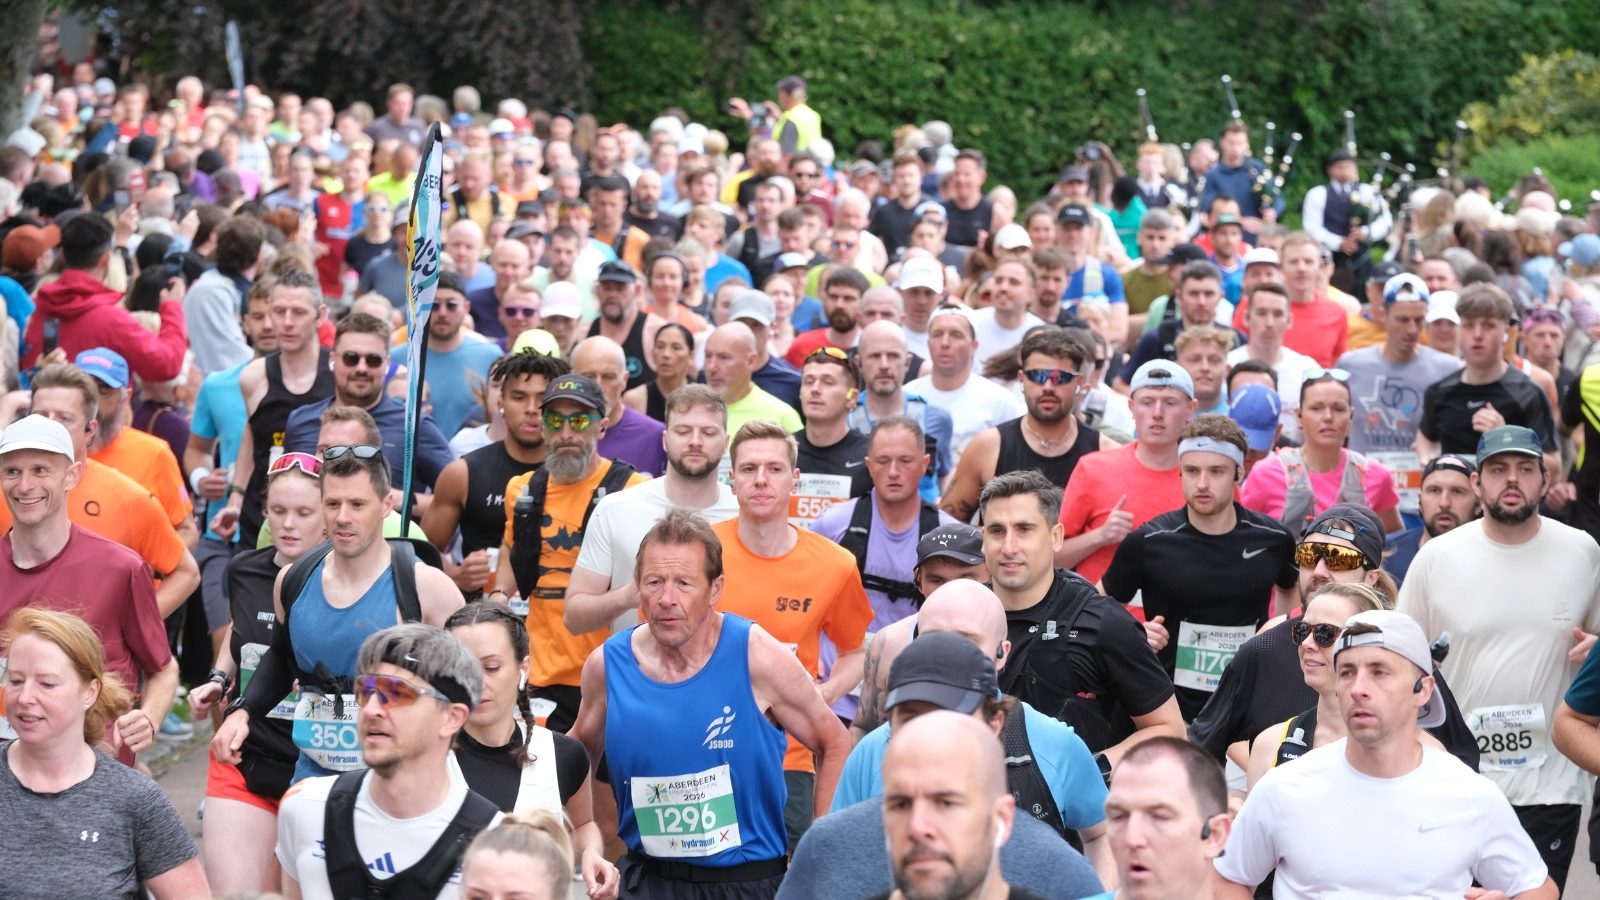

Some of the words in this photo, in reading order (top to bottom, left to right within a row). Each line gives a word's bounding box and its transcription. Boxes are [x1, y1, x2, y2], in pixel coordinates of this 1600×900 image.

[775, 596, 812, 613] gef
[1491, 709, 1532, 717] ABERDEEN
[309, 723, 359, 749] 350
[1476, 730, 1532, 754] 2885
[668, 774, 716, 789] ABERDEEN
[683, 791, 706, 801] 2026
[655, 802, 717, 833] 1296
